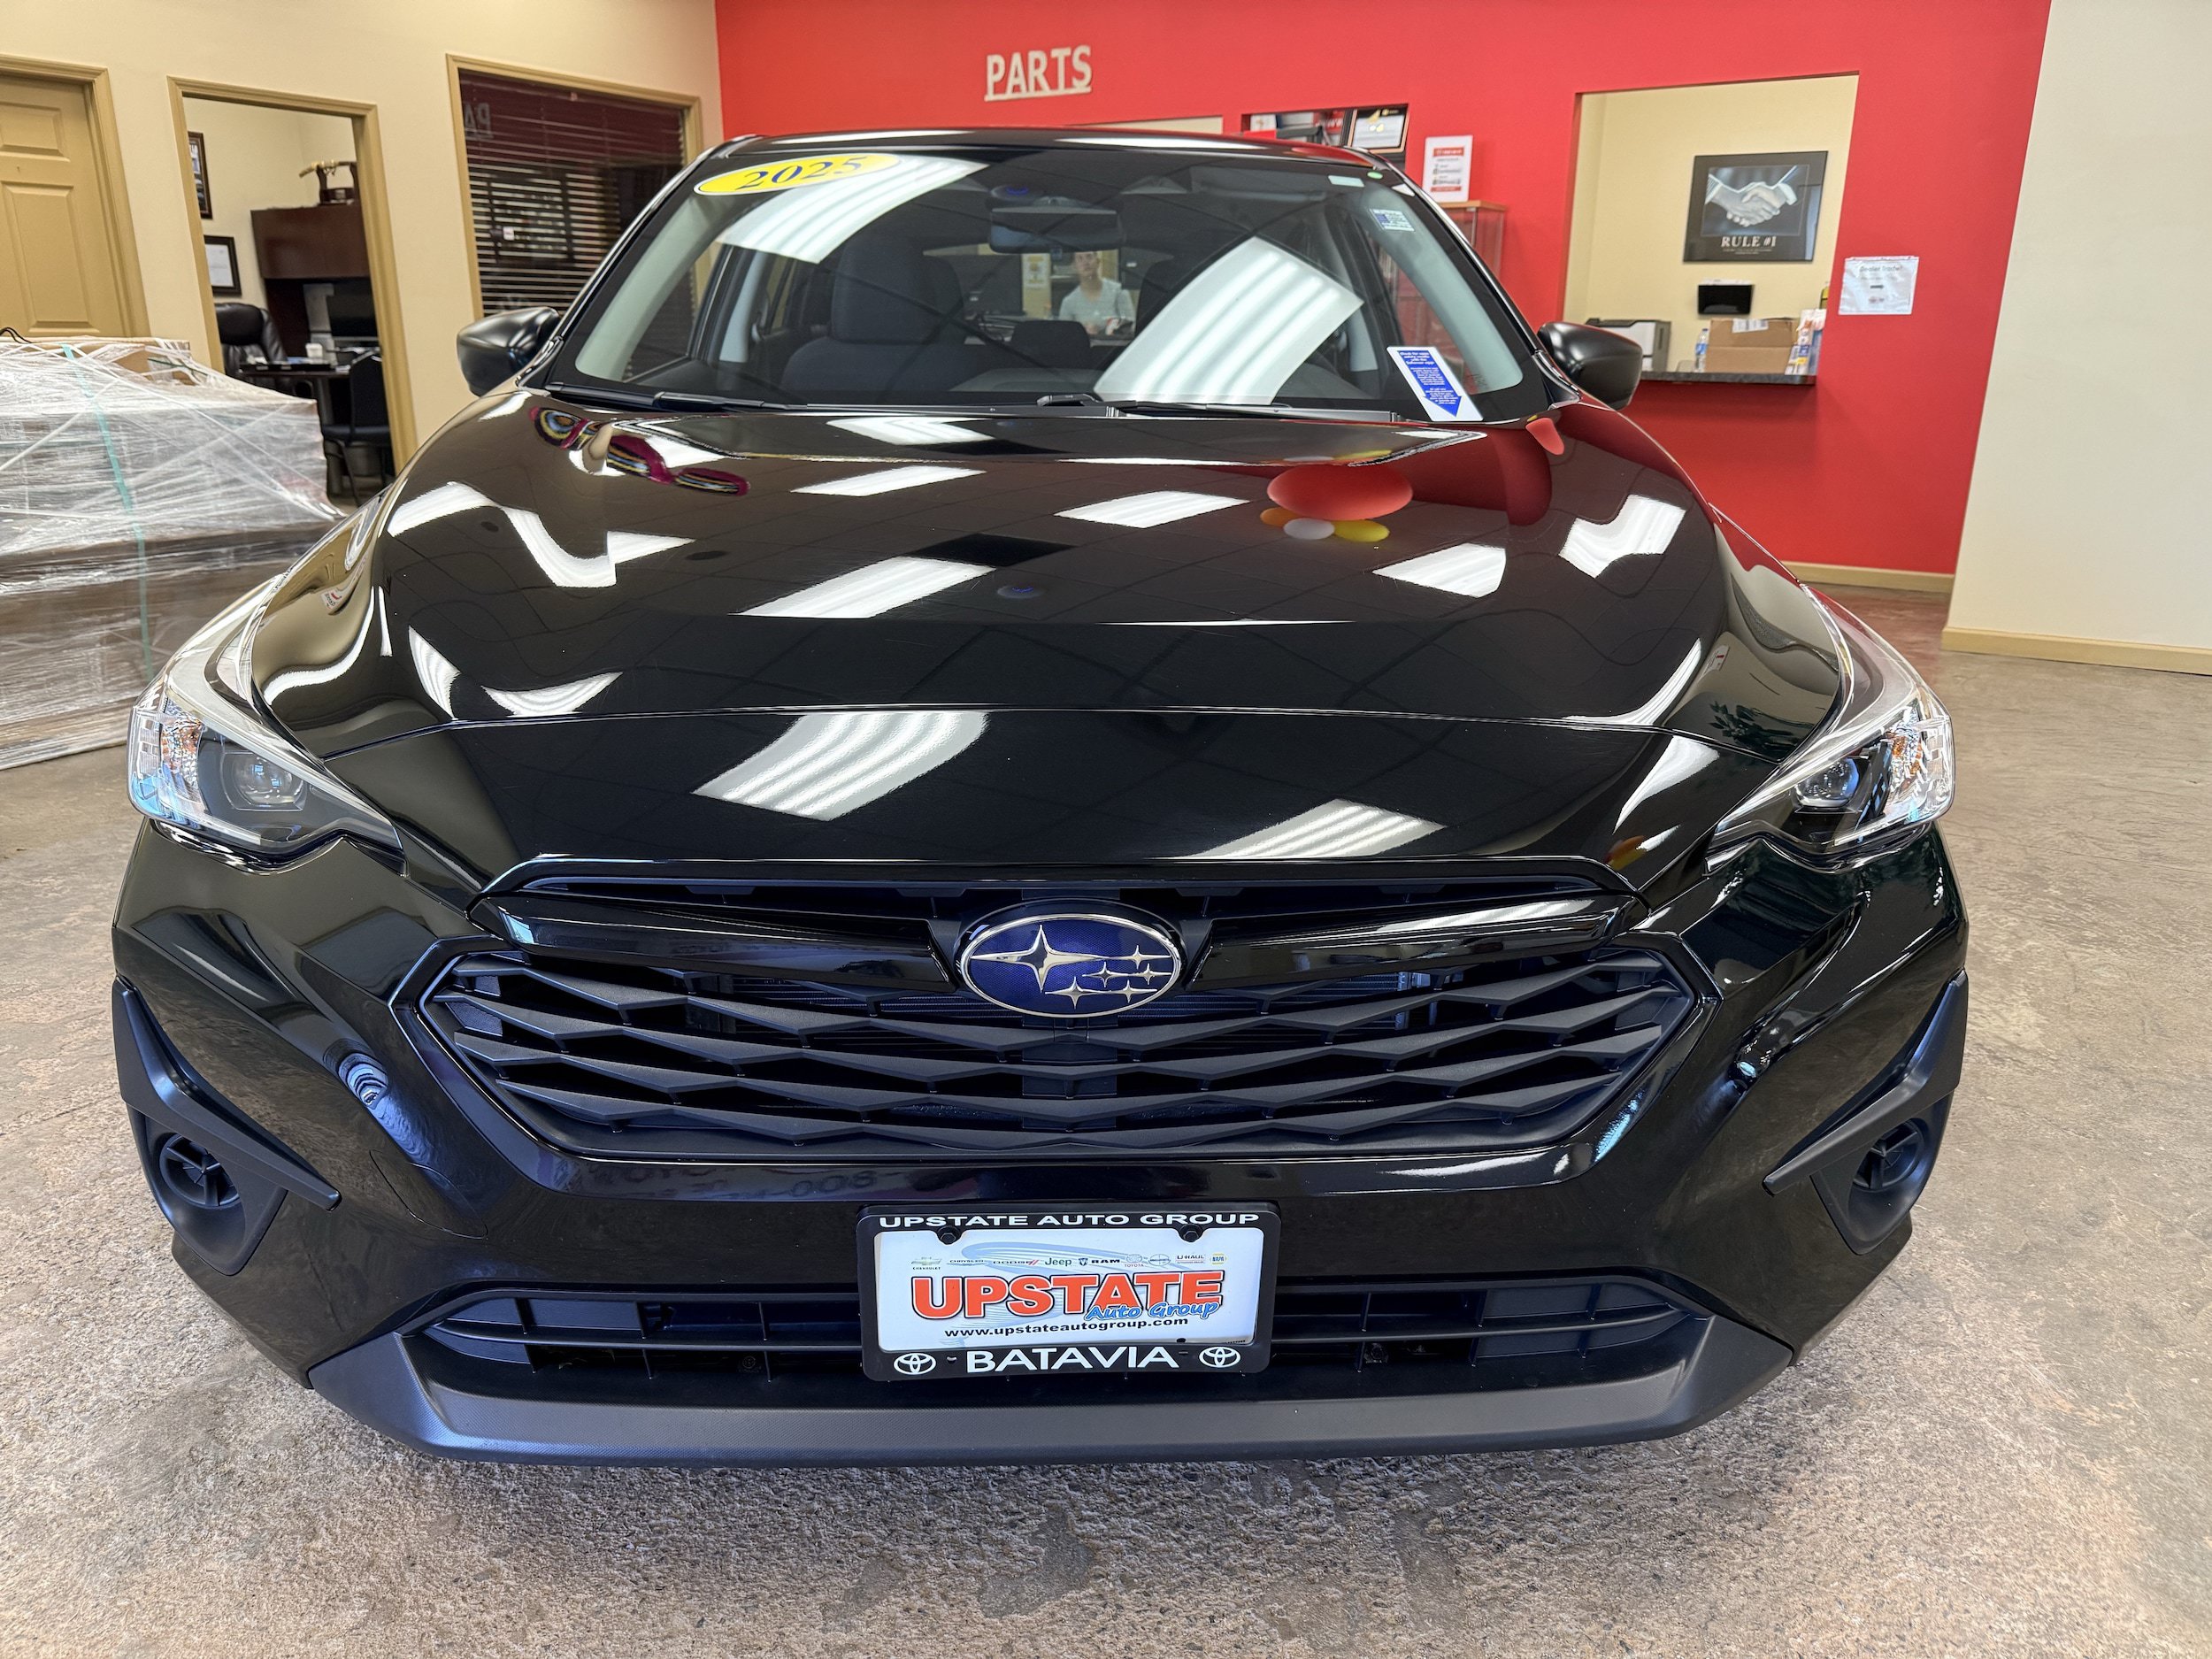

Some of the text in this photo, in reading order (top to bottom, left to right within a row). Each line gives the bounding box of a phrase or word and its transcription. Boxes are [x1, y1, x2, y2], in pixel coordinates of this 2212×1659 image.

[986, 44, 1092, 99] PARTS
[735, 156, 868, 190] 2025
[1721, 235, 1761, 248] RULE
[879, 1213, 1260, 1228] UPSTATE AUTO GROUP
[1045, 1257, 1072, 1267] Jeep
[910, 1271, 1225, 1319] UPSTATE
[1084, 1302, 1219, 1320] Auto Group
[944, 1318, 1188, 1337] www.upstateautogroup.com
[966, 1346, 1179, 1373] BATAVIA
